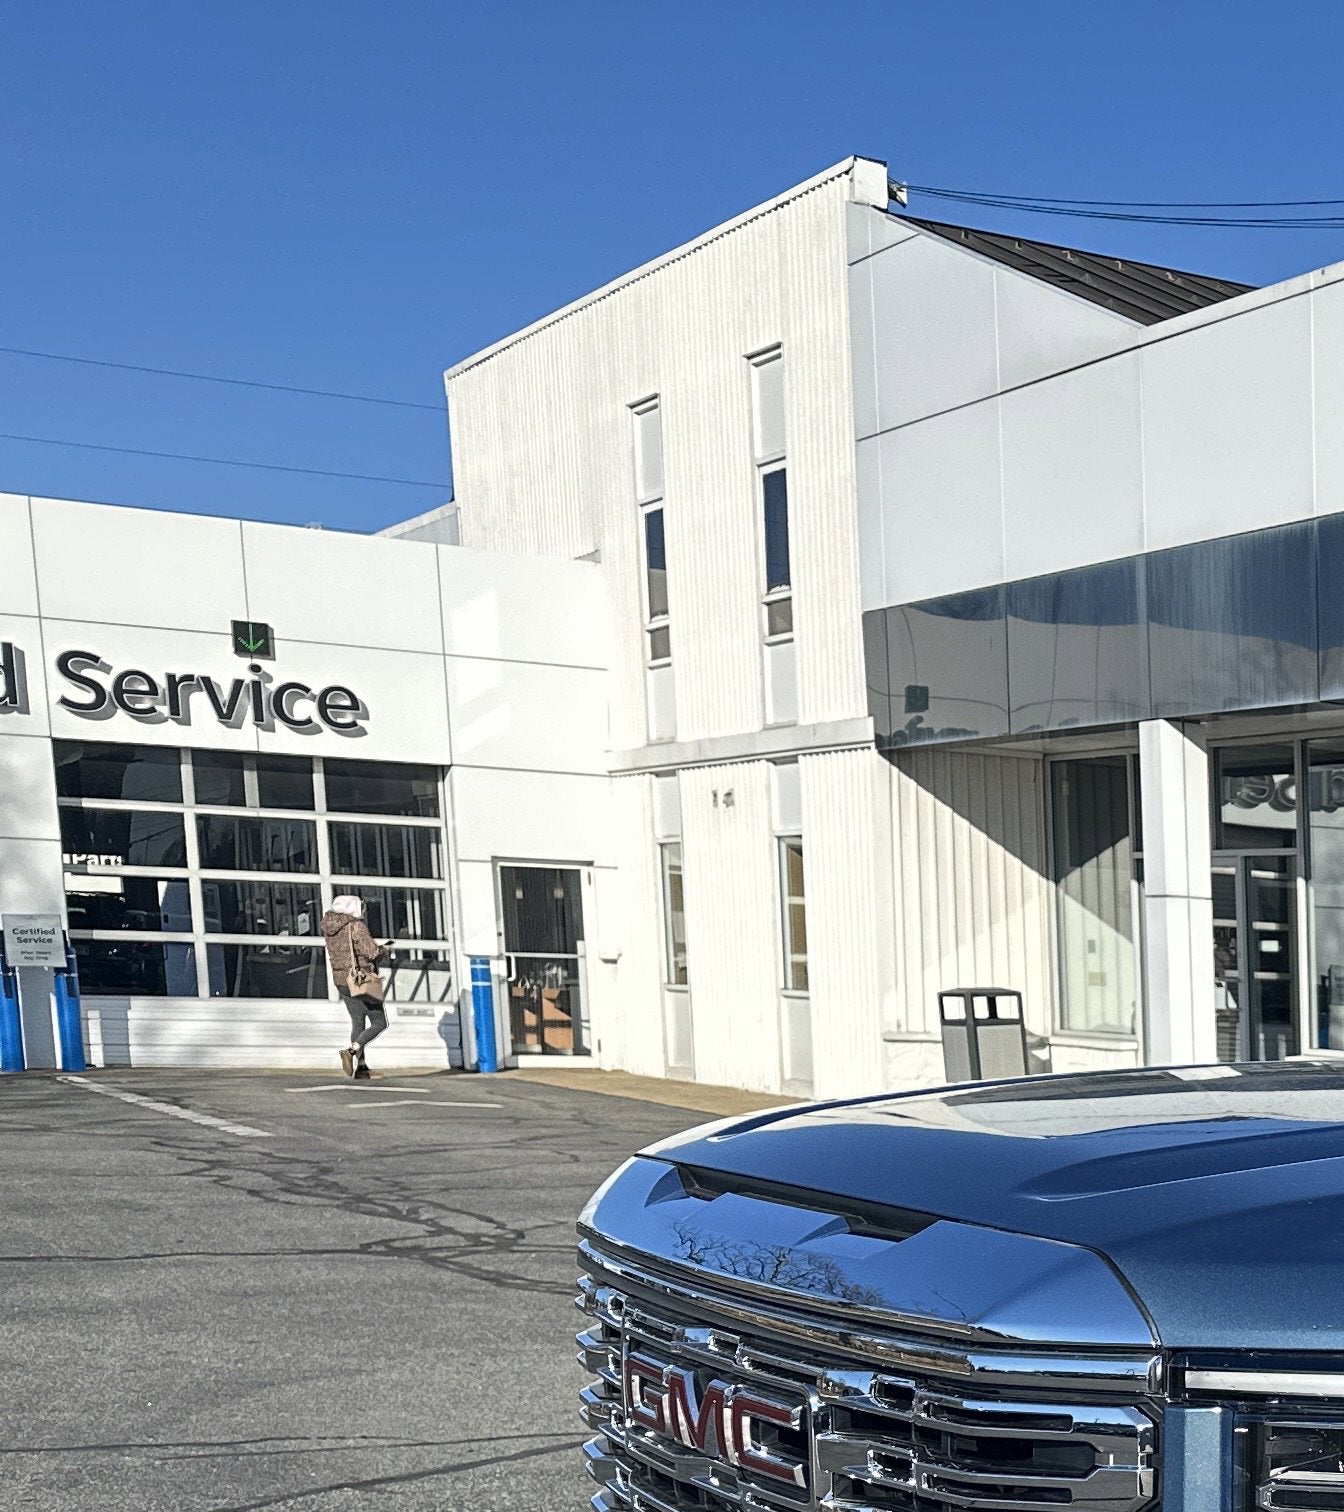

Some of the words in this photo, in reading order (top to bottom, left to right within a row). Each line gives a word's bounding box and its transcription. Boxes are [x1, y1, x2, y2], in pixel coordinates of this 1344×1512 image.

[57, 650, 363, 731] Service
[17, 936, 53, 944] Service
[624, 1350, 807, 1489] GMC
